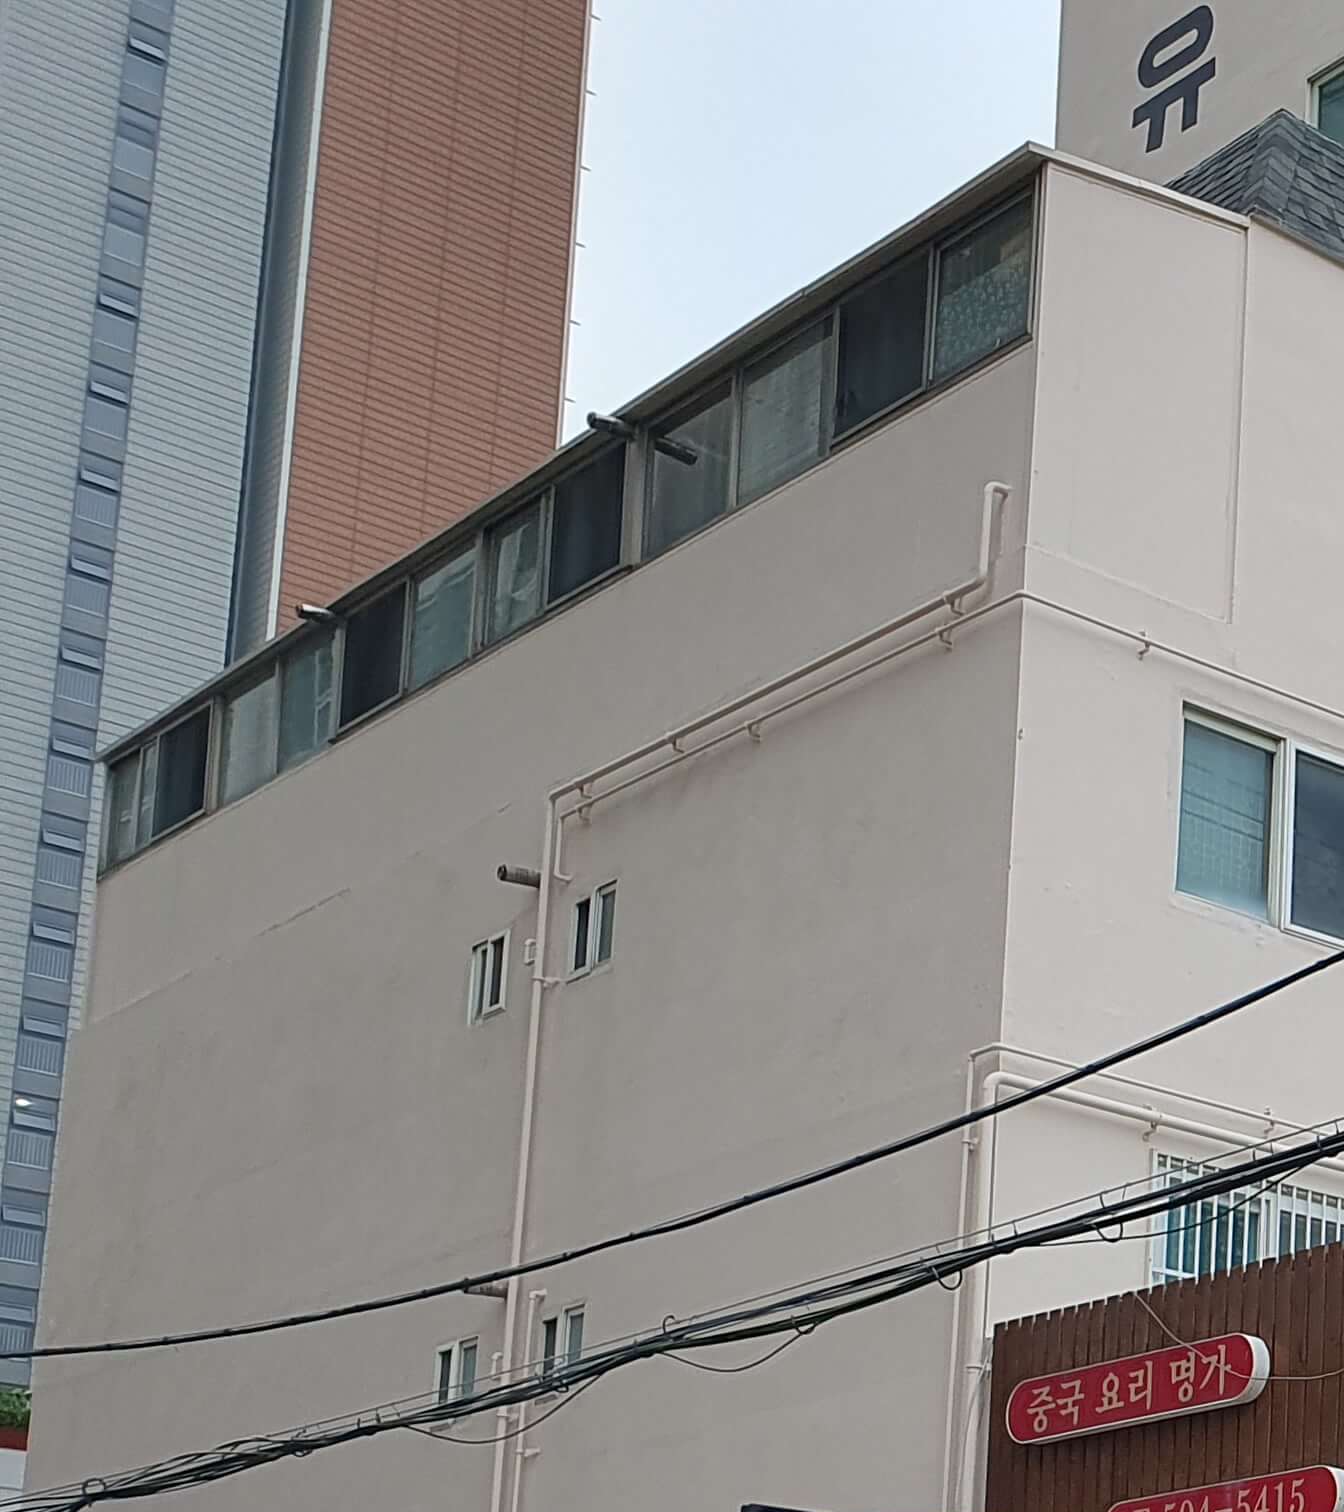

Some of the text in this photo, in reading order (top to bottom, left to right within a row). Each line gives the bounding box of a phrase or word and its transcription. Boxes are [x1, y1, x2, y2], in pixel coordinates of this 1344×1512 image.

[1026, 1343, 1231, 1433] 중국 요리 명가
